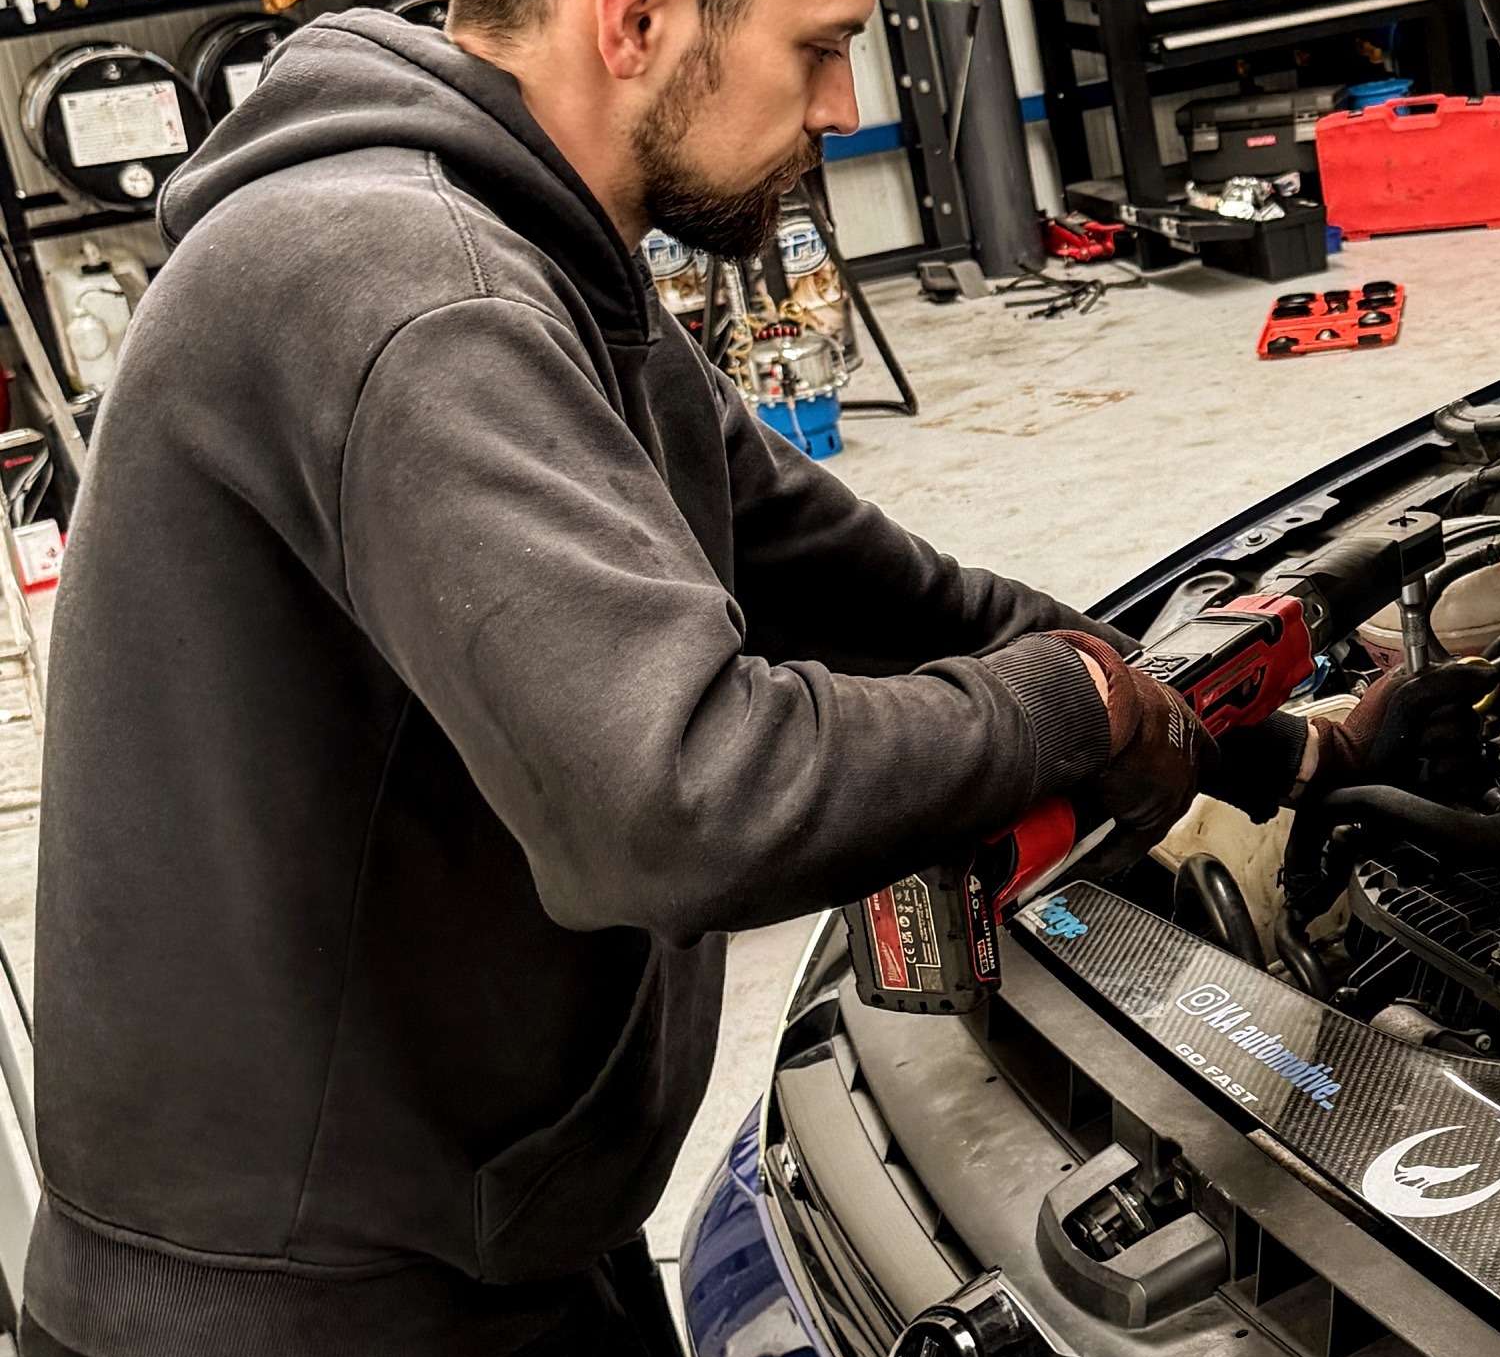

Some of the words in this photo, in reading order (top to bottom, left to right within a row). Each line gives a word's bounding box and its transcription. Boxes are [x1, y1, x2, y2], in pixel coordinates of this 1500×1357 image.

[1202, 1002, 1252, 1033] KA
[1175, 1043, 1207, 1066] GO
[1204, 1065, 1259, 1104] FAST
